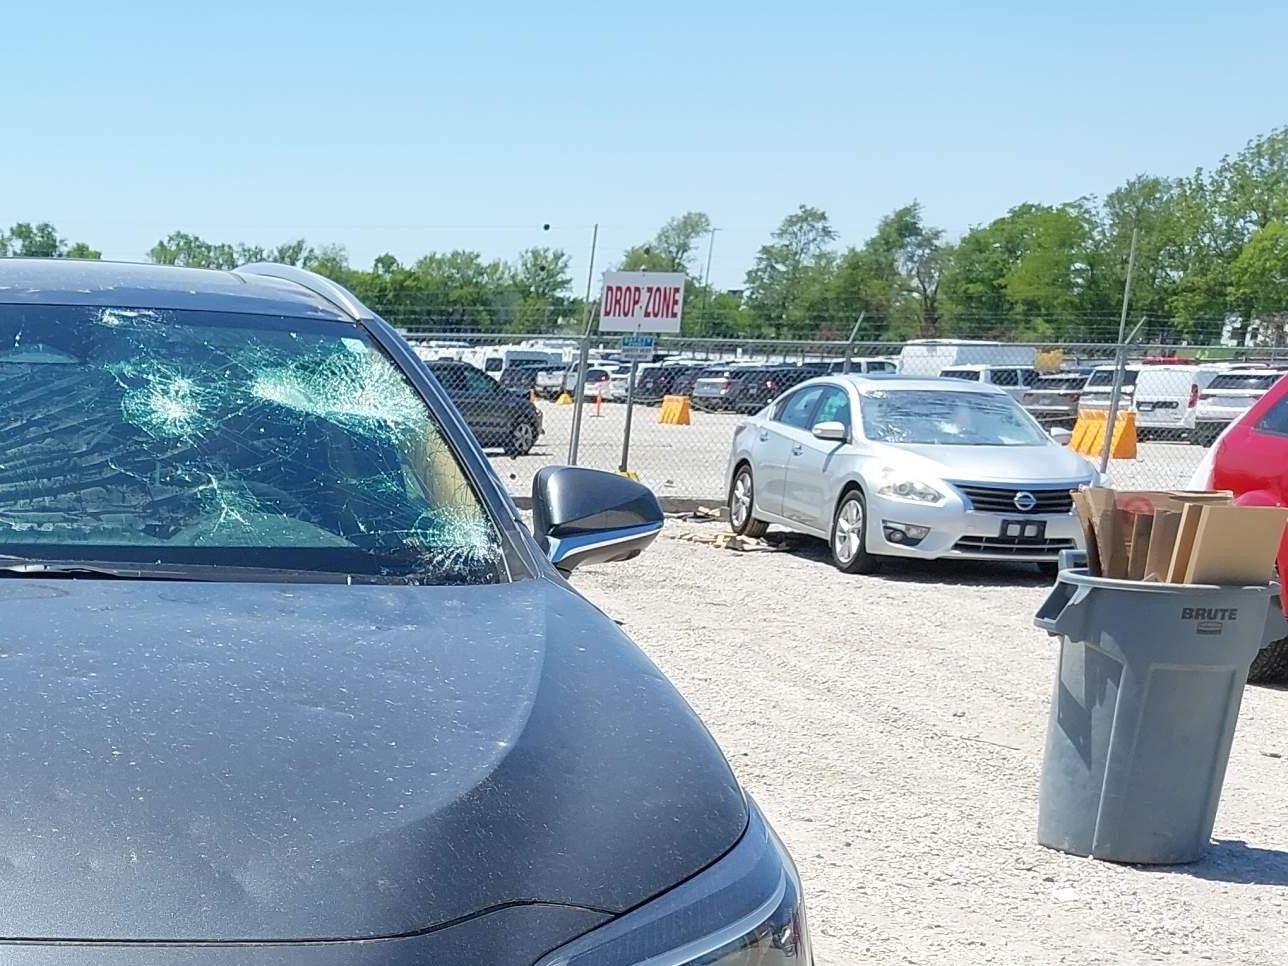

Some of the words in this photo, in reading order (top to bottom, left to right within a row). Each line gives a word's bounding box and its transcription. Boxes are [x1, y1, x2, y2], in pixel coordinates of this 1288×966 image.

[604, 285, 641, 317] DROP
[643, 286, 681, 318] ZONE
[1181, 607, 1238, 620] BRUTE
